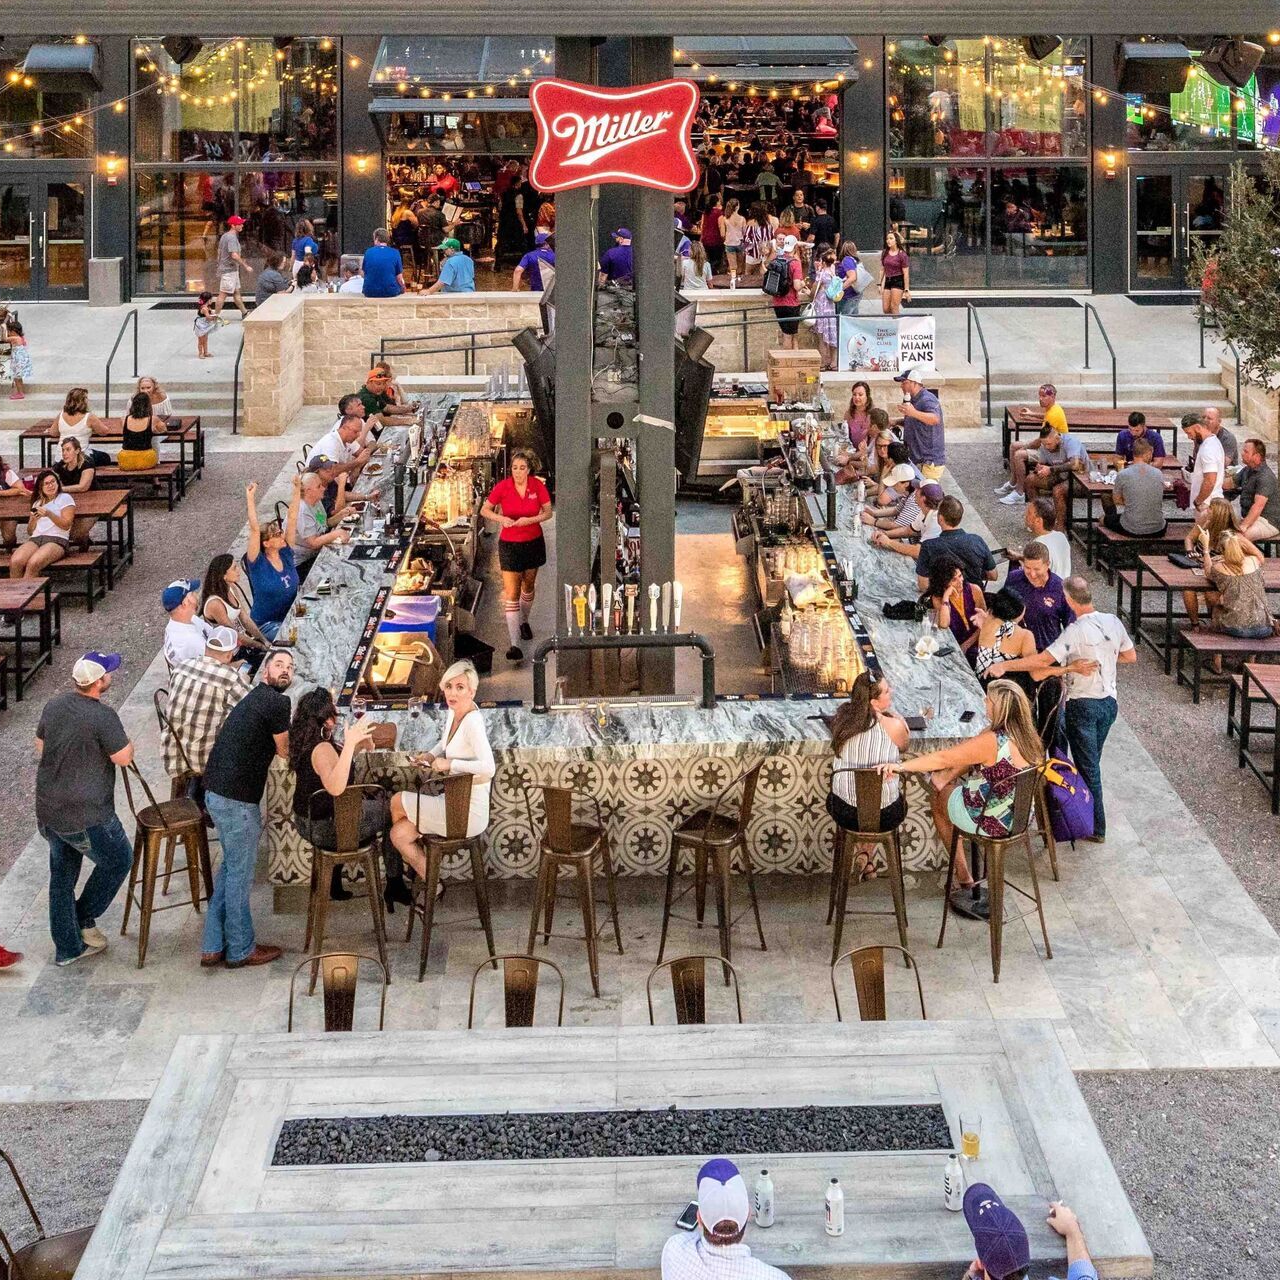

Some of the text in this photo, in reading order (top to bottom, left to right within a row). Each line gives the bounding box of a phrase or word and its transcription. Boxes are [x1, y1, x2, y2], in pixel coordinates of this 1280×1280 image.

[551, 110, 674, 157] Miller
[900, 341, 933, 350] MIAMI
[901, 351, 934, 362] FANS
